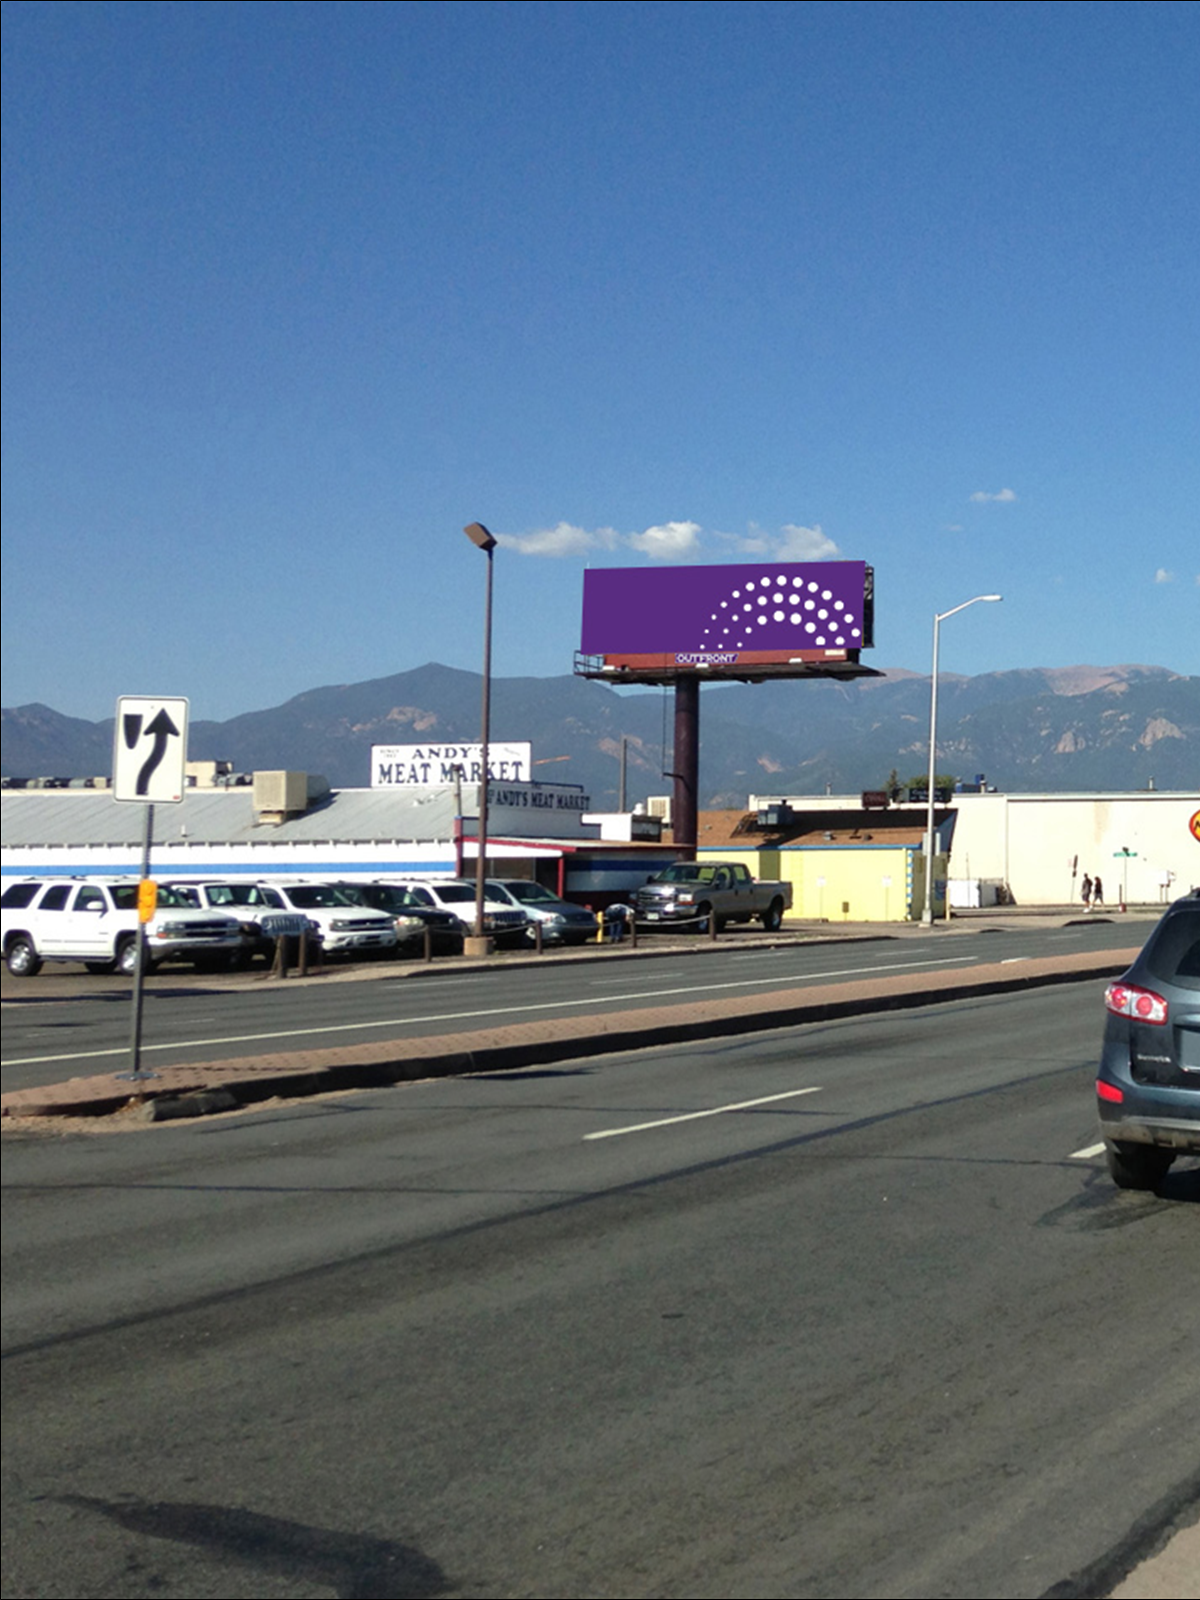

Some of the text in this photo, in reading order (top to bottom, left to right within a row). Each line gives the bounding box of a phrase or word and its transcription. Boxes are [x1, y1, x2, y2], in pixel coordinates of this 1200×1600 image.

[677, 653, 736, 663] OUTFRONT
[412, 747, 490, 760] ANDY'S
[378, 761, 523, 784] MEAT MARKET
[496, 790, 528, 807] ANDY'S
[531, 792, 554, 809] MEAT
[556, 794, 590, 811] MARKET
